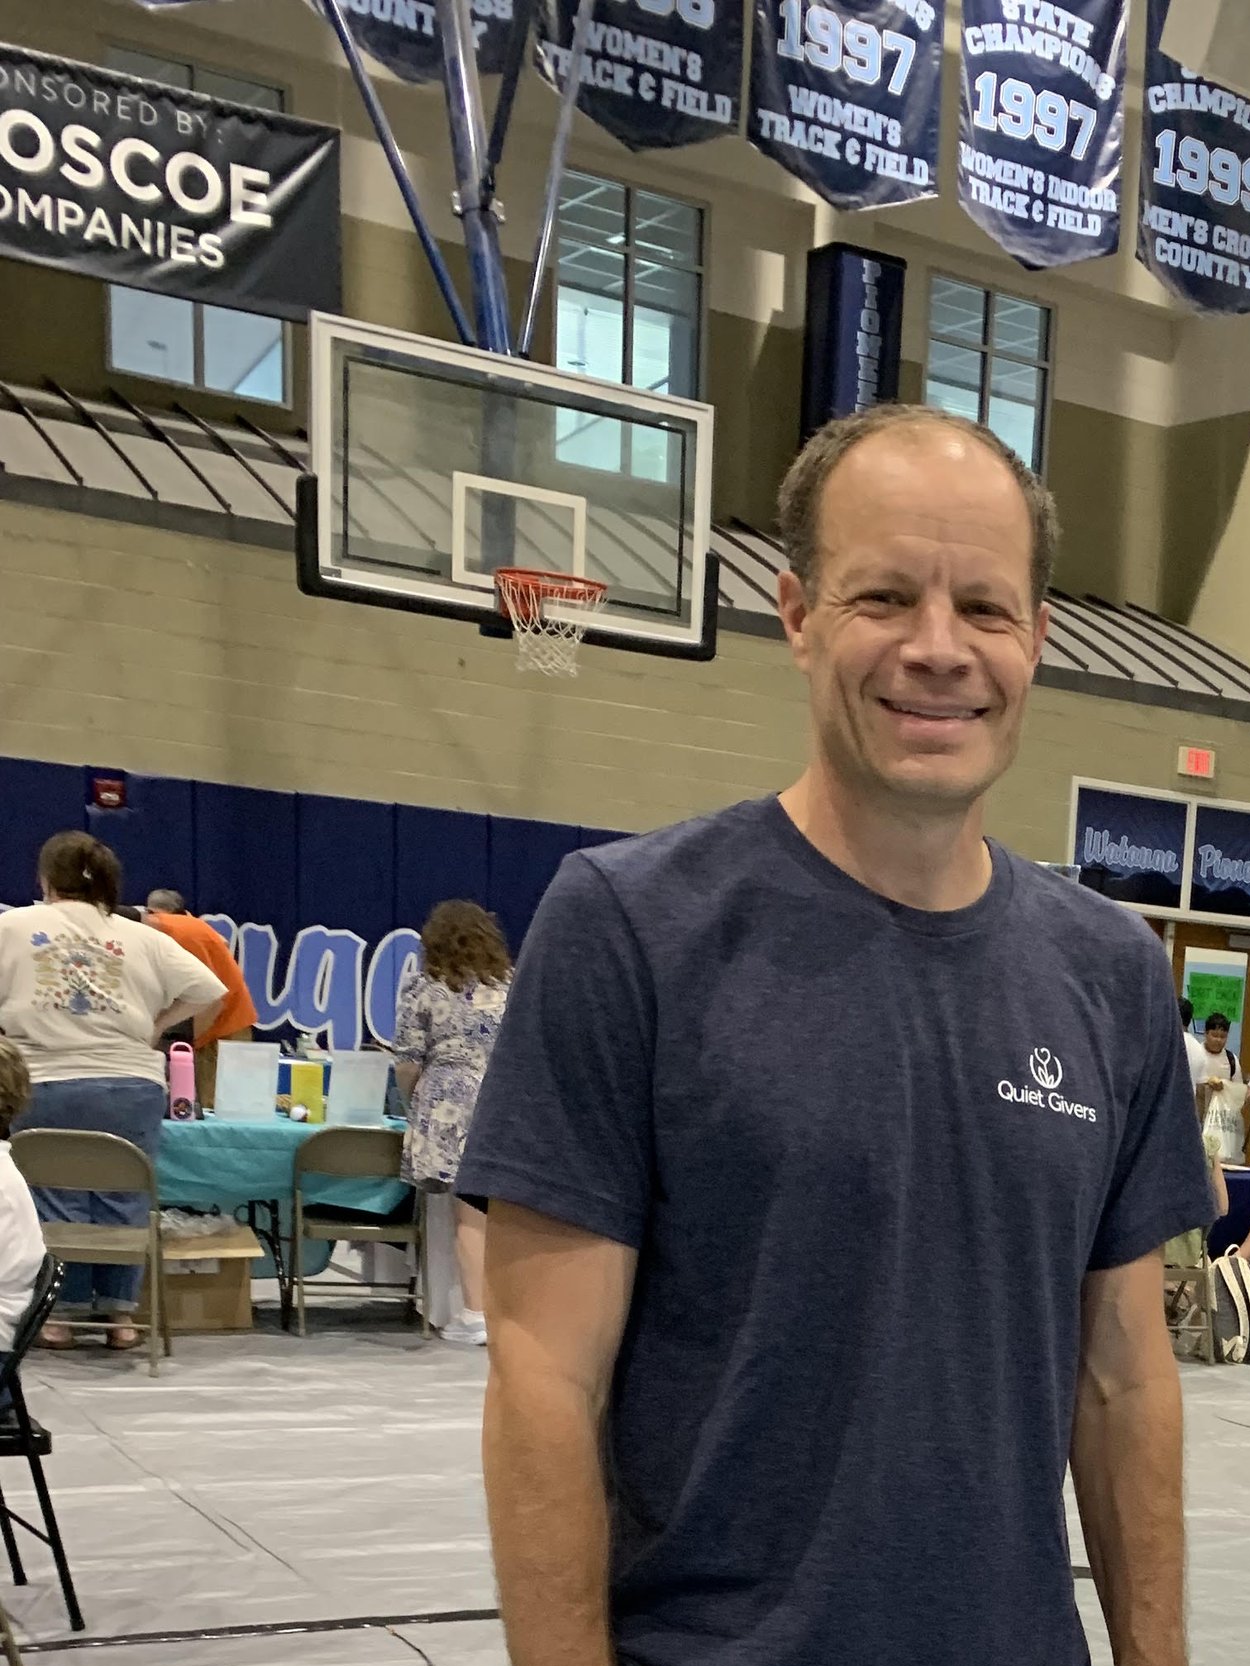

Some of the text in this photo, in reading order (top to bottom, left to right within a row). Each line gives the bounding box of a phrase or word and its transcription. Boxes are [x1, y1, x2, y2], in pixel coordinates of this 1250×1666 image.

[777, 0, 916, 95] 1997
[1002, 0, 1094, 48] STATE
[965, 23, 1116, 100] CHAMPIONS
[661, 77, 732, 125] FIELD
[788, 84, 902, 148] WOMEN'S
[973, 71, 1097, 160] 1997
[0, 108, 272, 227] OSCOE
[757, 108, 842, 160] TRACK
[864, 142, 929, 186] FIELD
[959, 140, 1117, 212] WOMEN'S INDOOR
[968, 175, 1031, 219] TRACK
[1047, 206, 1101, 236] FIELD
[1143, 201, 1209, 245] MEN'S
[997, 1079, 1097, 1123] Quiet Givers
